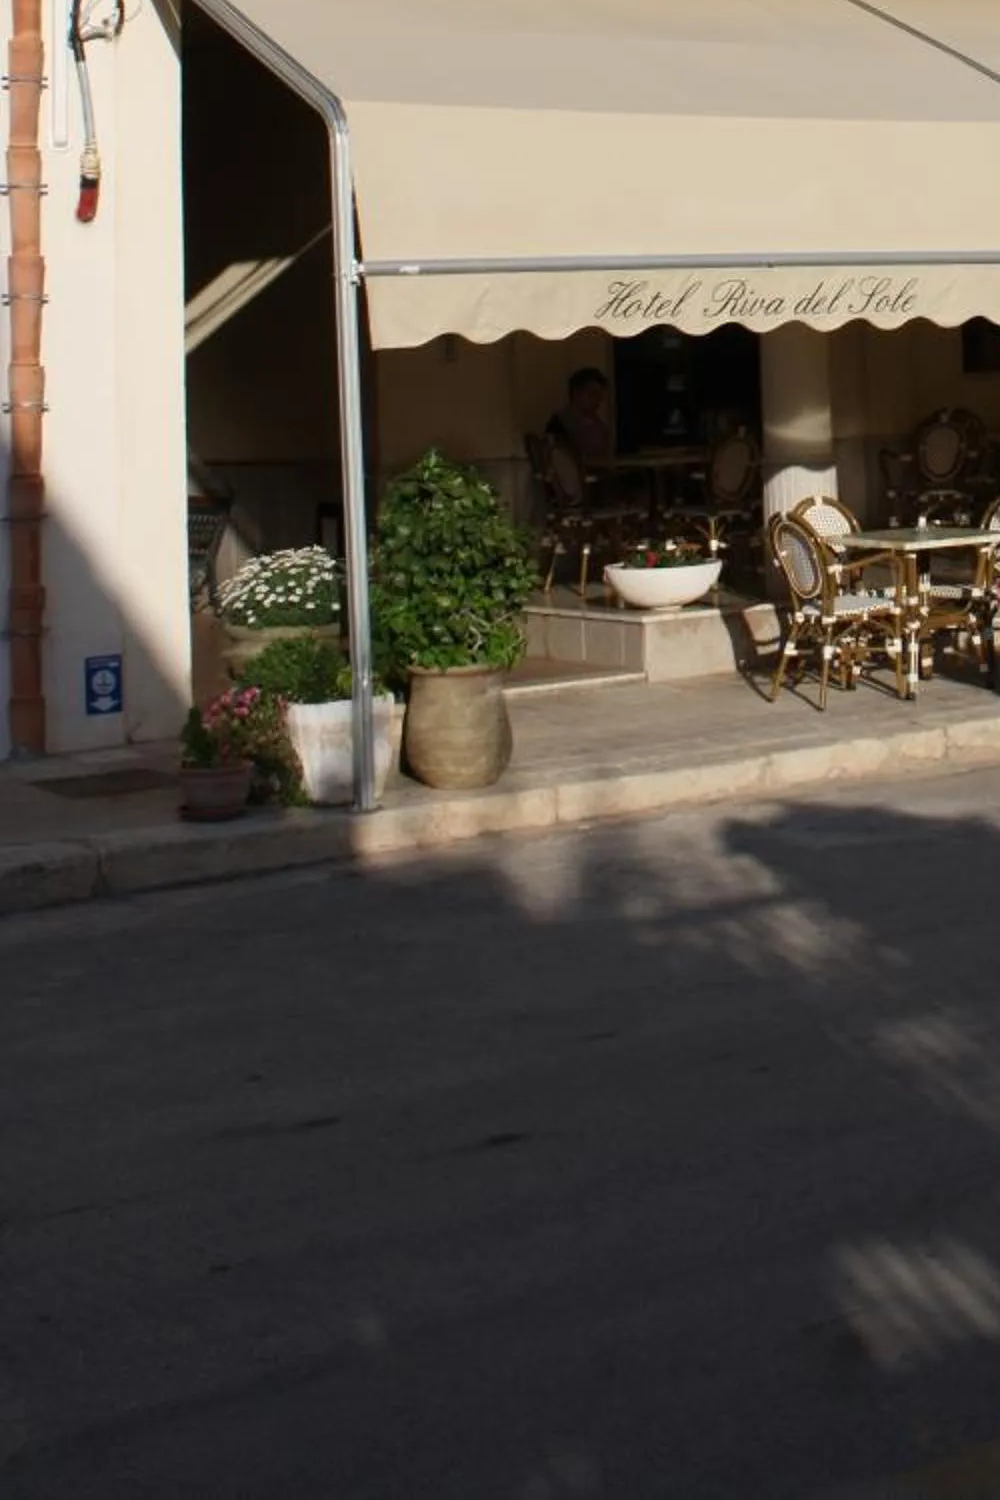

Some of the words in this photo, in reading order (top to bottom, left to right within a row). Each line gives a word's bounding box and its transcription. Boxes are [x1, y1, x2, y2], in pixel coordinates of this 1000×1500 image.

[594, 273, 702, 321] Hotel
[703, 279, 786, 318] Riva
[793, 278, 846, 317] del
[848, 276, 919, 315] Sole
